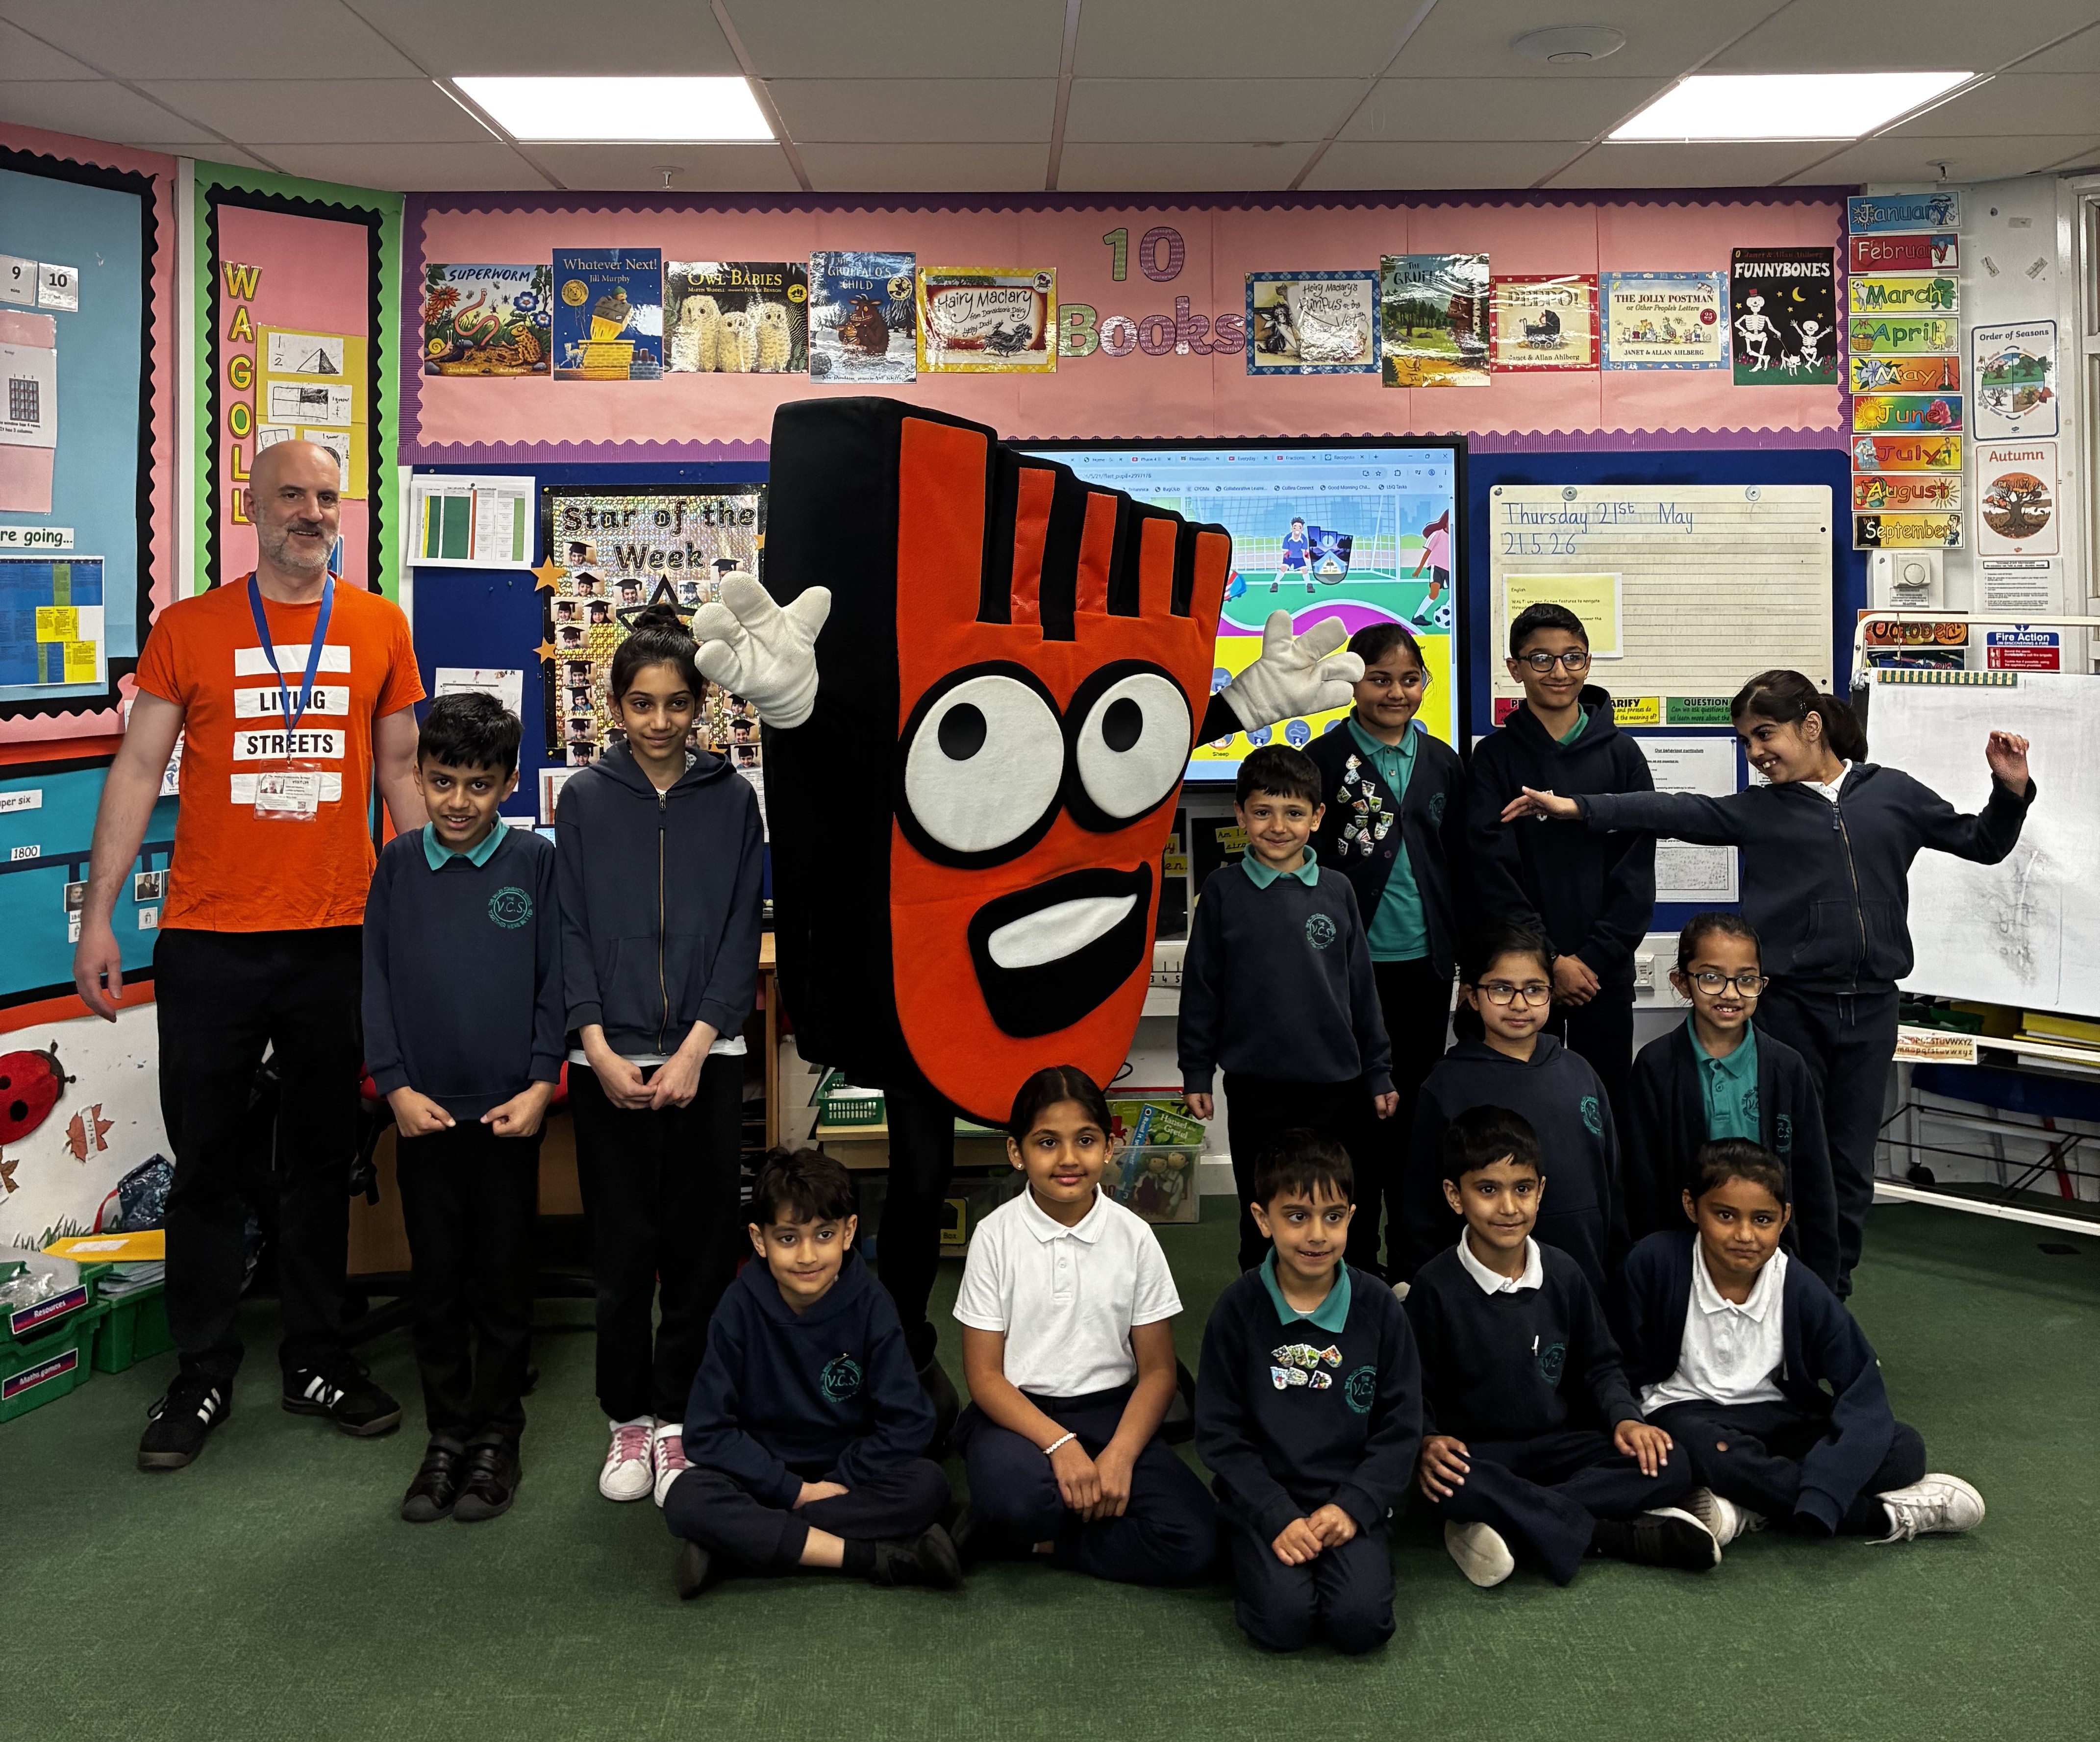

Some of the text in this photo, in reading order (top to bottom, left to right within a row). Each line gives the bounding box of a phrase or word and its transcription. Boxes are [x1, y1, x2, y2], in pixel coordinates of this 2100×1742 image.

[1859, 203, 1949, 225] January
[1103, 227, 1185, 281] 10
[1858, 242, 1948, 264] February
[12, 266, 21, 280] 9
[563, 258, 656, 270] Whatever Next!
[1734, 262, 1830, 278] FUNNYBONES
[49, 273, 68, 287] 10
[448, 268, 530, 282] SUPERWORM
[590, 274, 630, 284] Jill Murphy
[731, 270, 782, 286] BABIES
[1638, 295, 1666, 303] JOLLY
[1866, 283, 1942, 304] March
[977, 290, 1032, 322] Maclary
[1059, 296, 1245, 356] Books
[1873, 322, 1937, 347] April
[2005, 331, 2013, 340] of
[2016, 329, 2049, 338] Seasons
[274, 358, 283, 366] 2
[1875, 366, 1936, 386] May
[1875, 405, 1941, 423] June
[1875, 445, 1941, 465] July
[1989, 450, 2045, 462] Autumn
[1868, 481, 1950, 503] August
[563, 500, 756, 537] Star of the
[1501, 502, 1693, 534] Thursday 21st May
[0, 528, 73, 547] re going...
[1866, 520, 1951, 544] September
[614, 541, 704, 571] Week
[1996, 633, 2050, 641] Fire Action
[1611, 699, 1640, 707] ARIFY
[247, 734, 333, 755] STREETS
[18, 796, 31, 805] six
[14, 846, 38, 859] 1800
[1160, 1113, 1188, 1129] Hansel
[34, 1300, 67, 1318] Resources
